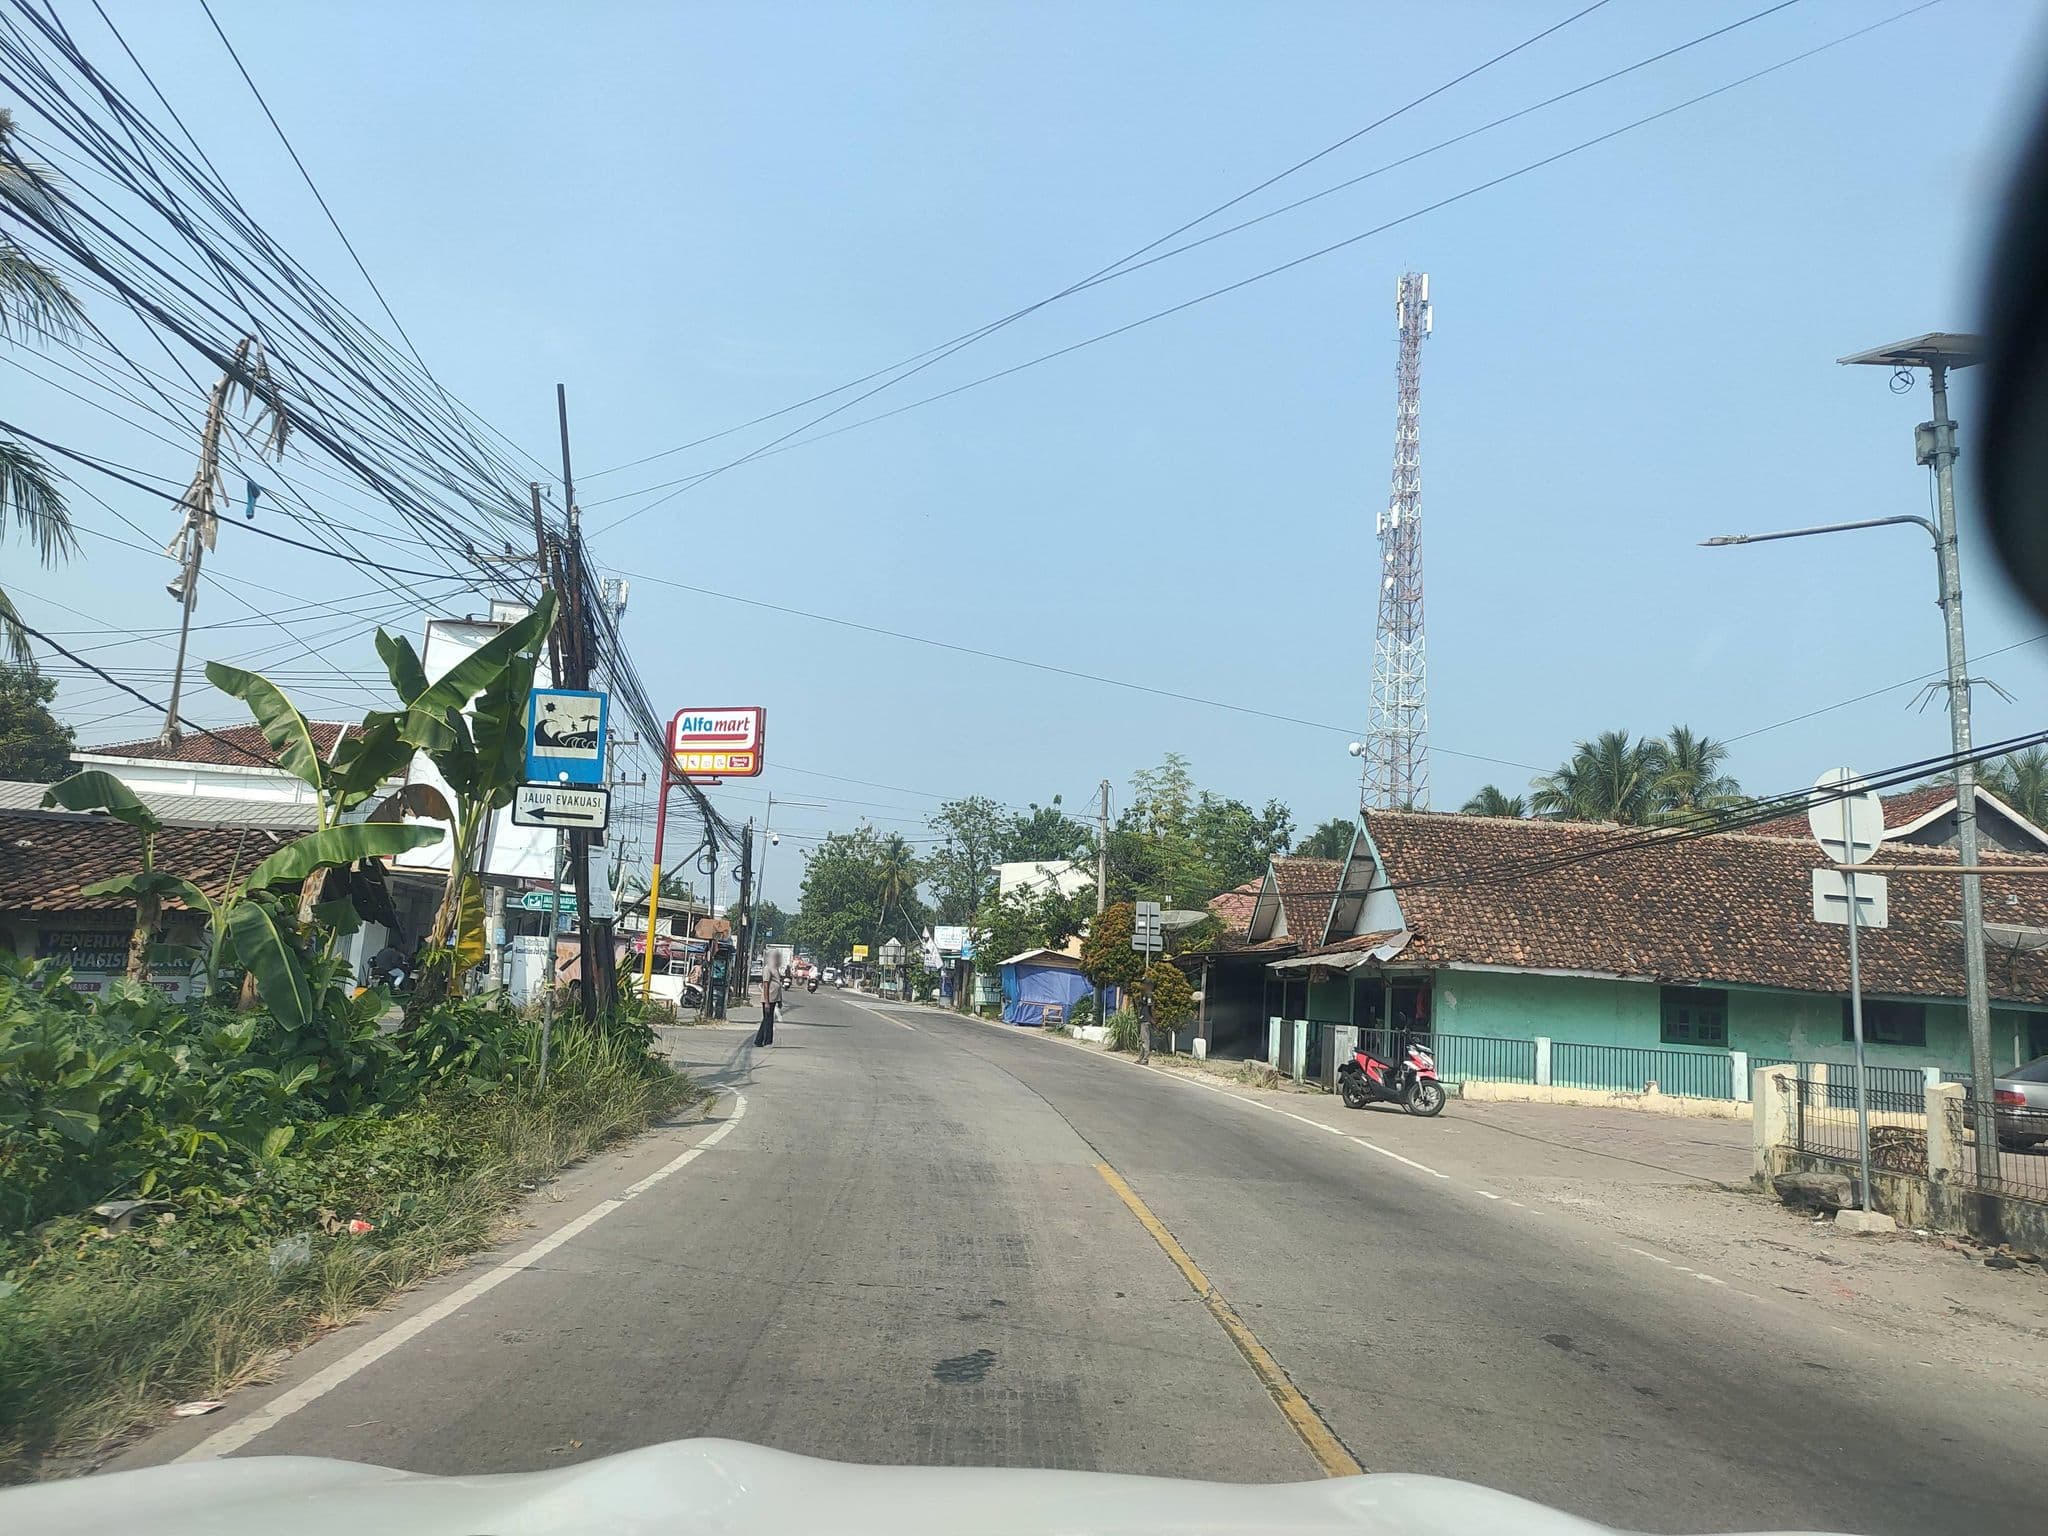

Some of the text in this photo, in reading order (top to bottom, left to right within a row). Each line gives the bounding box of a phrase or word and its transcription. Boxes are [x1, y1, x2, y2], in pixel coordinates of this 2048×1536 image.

[682, 717, 750, 732] Alfamart
[523, 792, 601, 808] JALUR EVAKUASI
